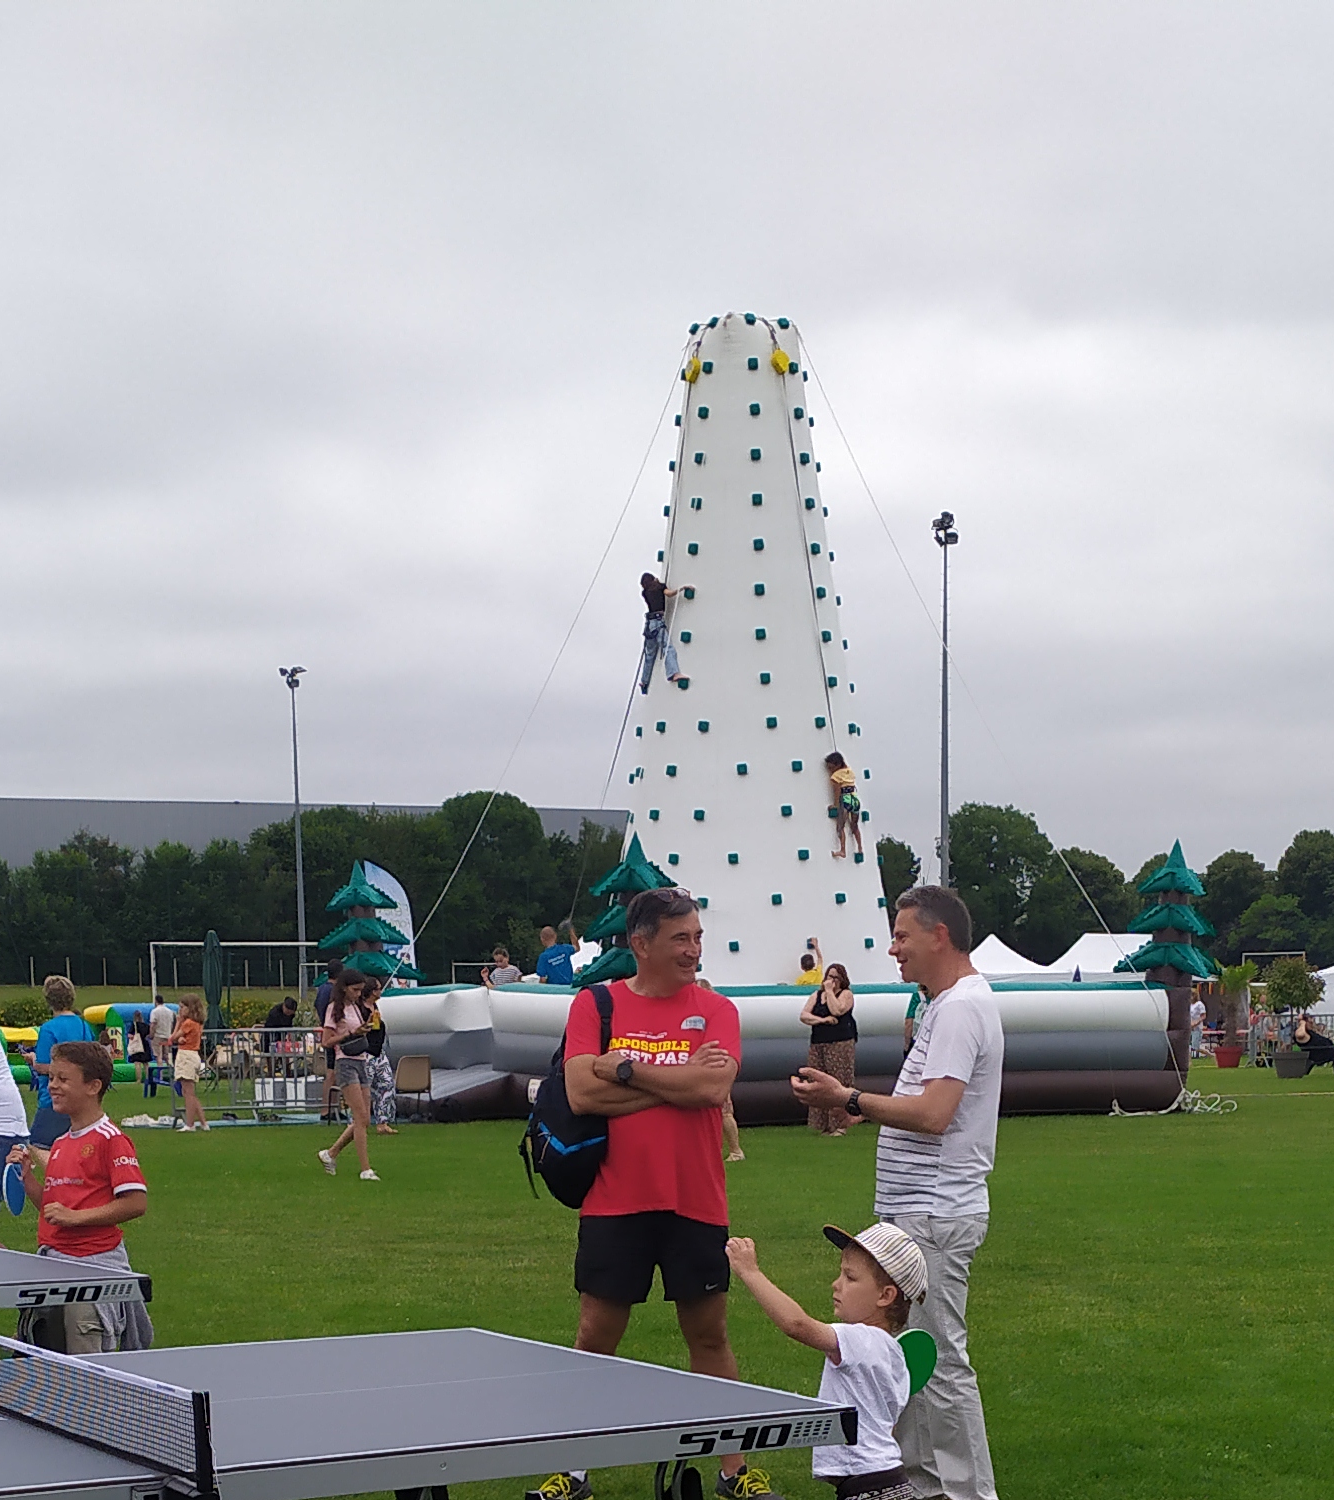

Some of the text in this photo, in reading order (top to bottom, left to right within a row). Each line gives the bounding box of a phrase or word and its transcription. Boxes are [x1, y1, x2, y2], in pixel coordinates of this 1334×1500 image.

[608, 1037, 690, 1053] IMPOSSIBLE
[654, 1051, 689, 1065] PAS
[16, 1285, 103, 1306] 540
[675, 1423, 793, 1458] 540
